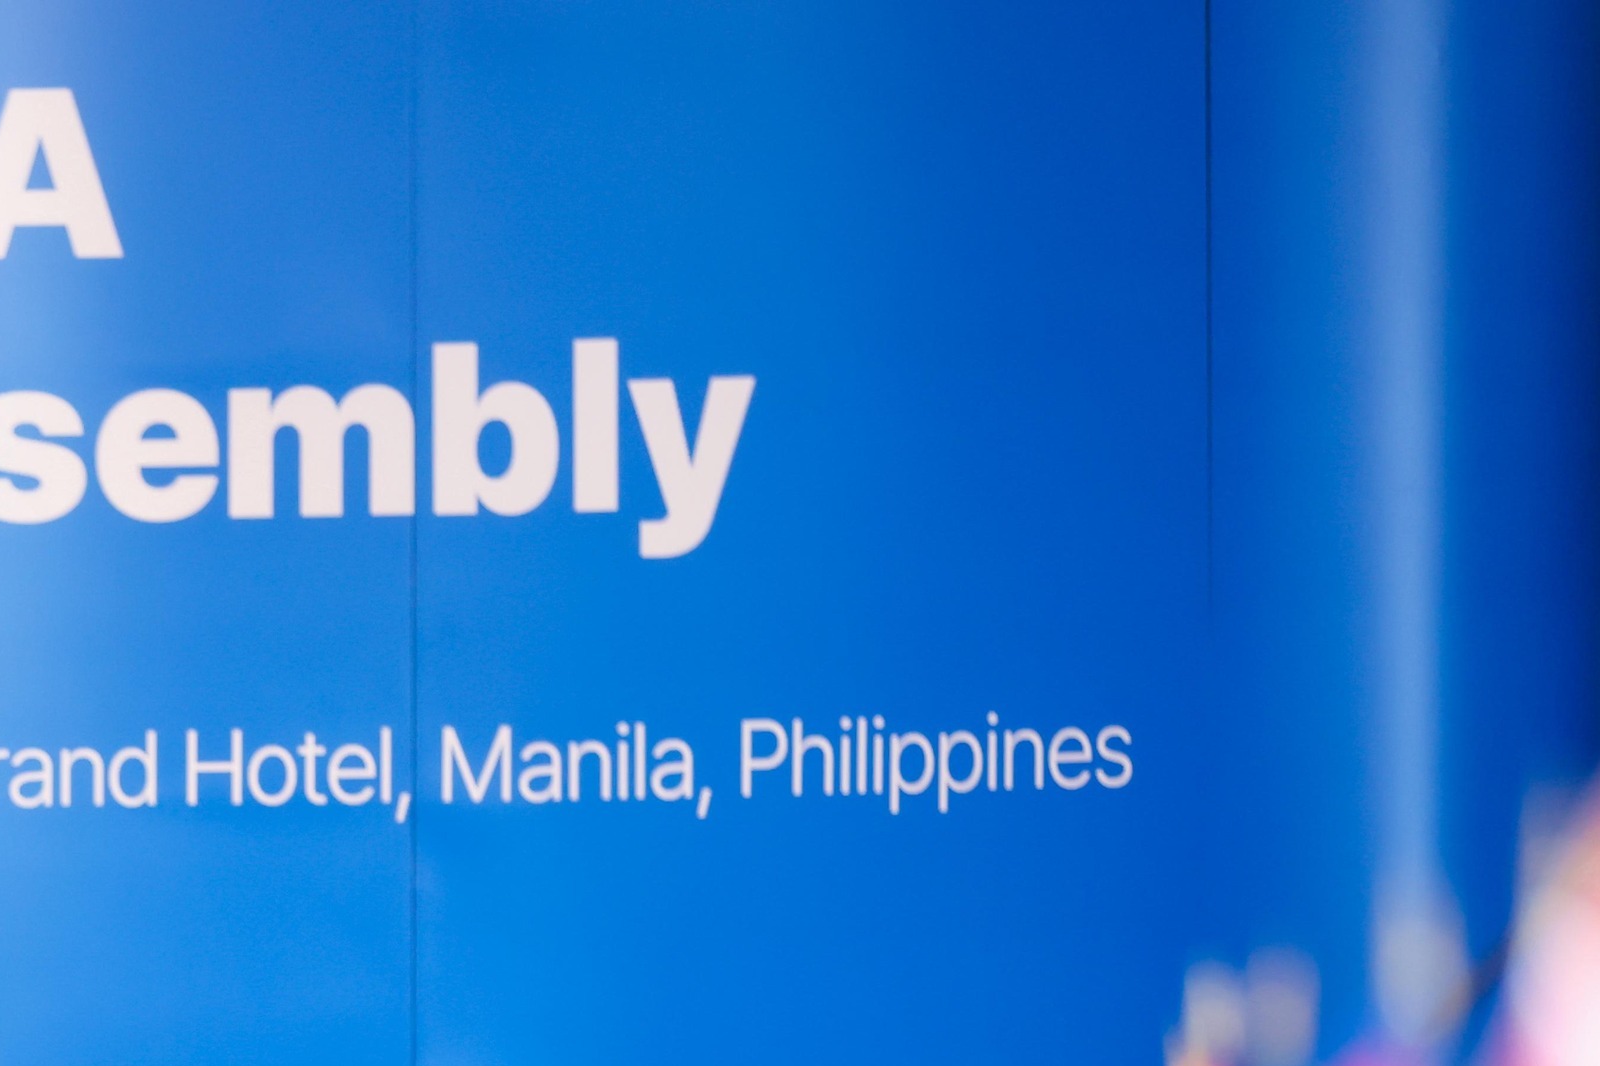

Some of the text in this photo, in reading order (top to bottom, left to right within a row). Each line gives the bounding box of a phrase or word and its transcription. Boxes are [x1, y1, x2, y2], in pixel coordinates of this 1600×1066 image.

[185, 726, 412, 823] Hotel,
[440, 722, 712, 819] Manila,
[740, 711, 1133, 814] Philippines
